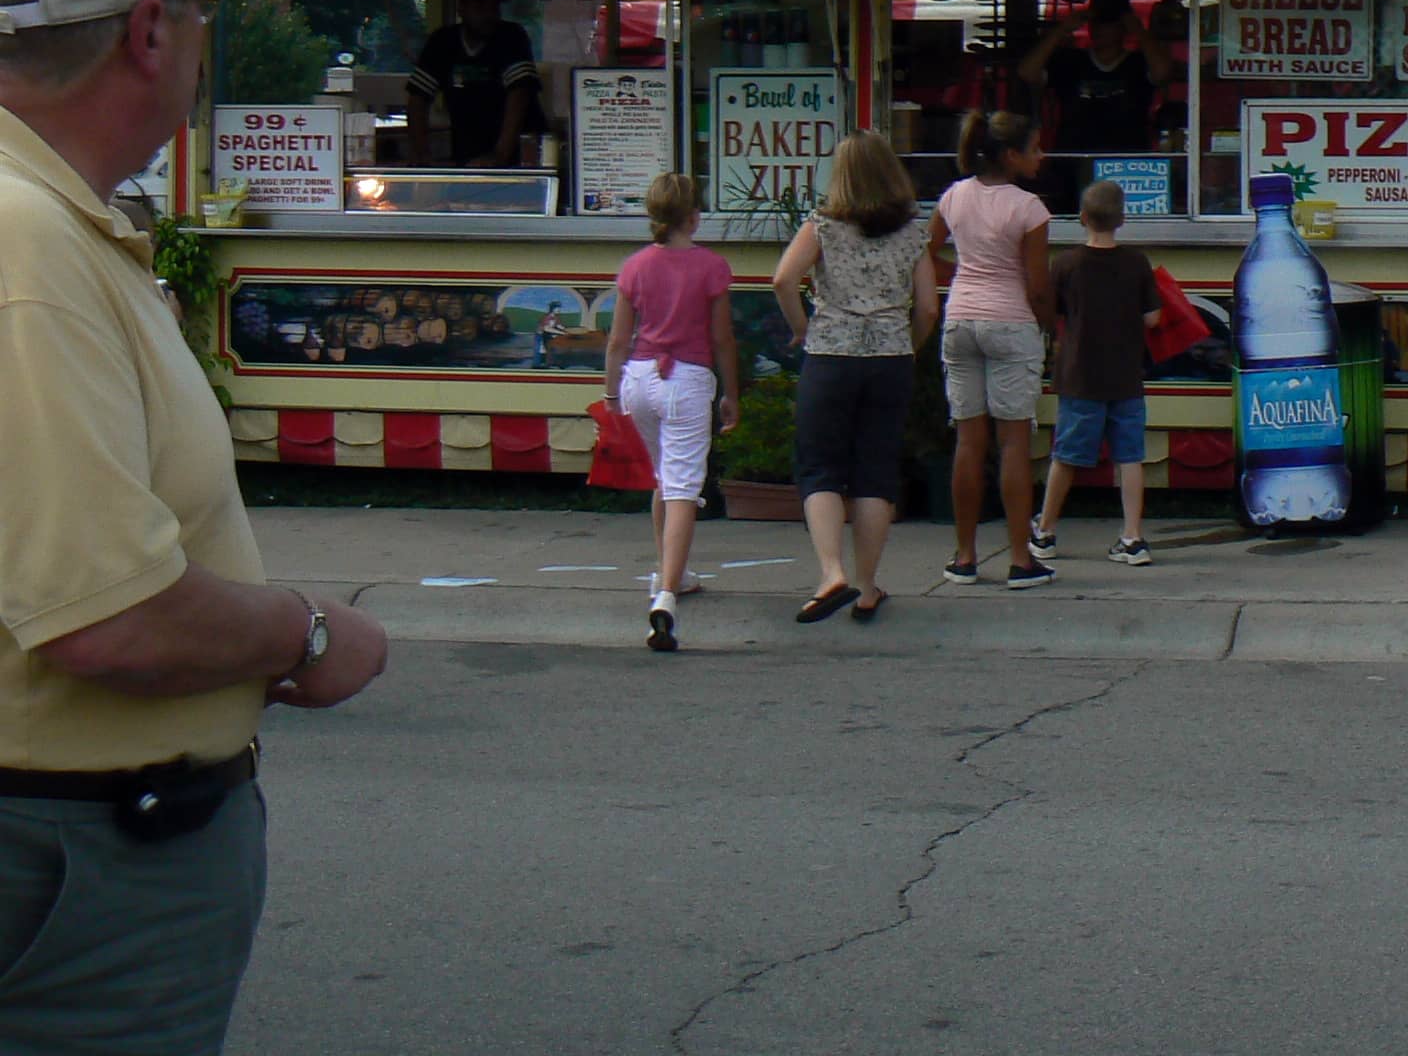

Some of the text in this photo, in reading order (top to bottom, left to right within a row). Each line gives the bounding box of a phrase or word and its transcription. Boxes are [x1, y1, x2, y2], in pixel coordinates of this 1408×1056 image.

[1240, 18, 1352, 55] BREAD
[1227, 60, 1365, 74] WITH SAUCE
[742, 83, 822, 112] Bowl of
[244, 114, 286, 130] 99
[218, 134, 333, 151] SPAGHETTI
[724, 120, 836, 157] BAKED
[232, 155, 319, 171] SPECIAL
[1097, 161, 1168, 176] ICE COLD
[747, 165, 816, 201] ZITI
[1327, 168, 1400, 184] PEPPERONI
[1248, 388, 1338, 430] AQUAFINA
